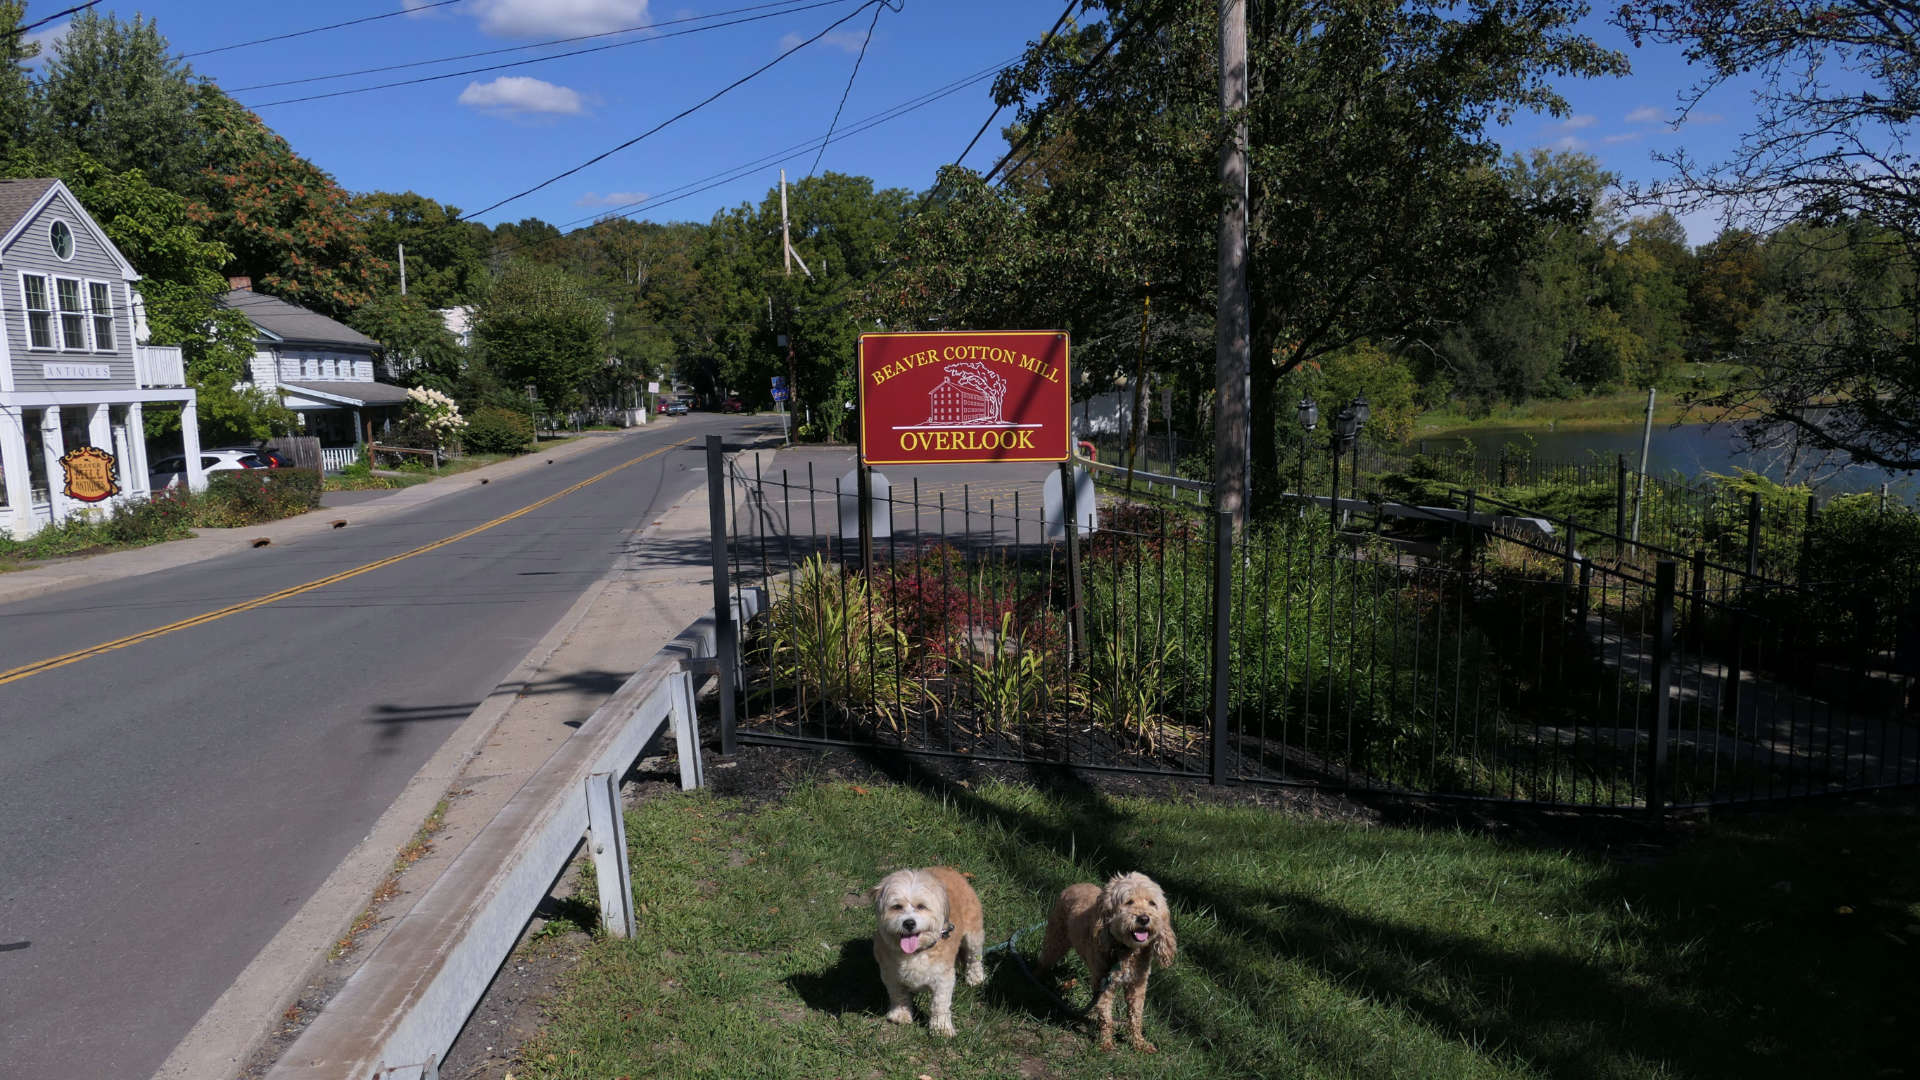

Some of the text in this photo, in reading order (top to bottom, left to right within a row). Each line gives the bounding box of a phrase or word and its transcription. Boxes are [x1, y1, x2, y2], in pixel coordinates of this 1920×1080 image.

[46, 366, 109, 377] ANTIQUES
[871, 345, 1060, 386] BEAVER COTTON MILL
[899, 430, 1036, 451] OVERLOOK
